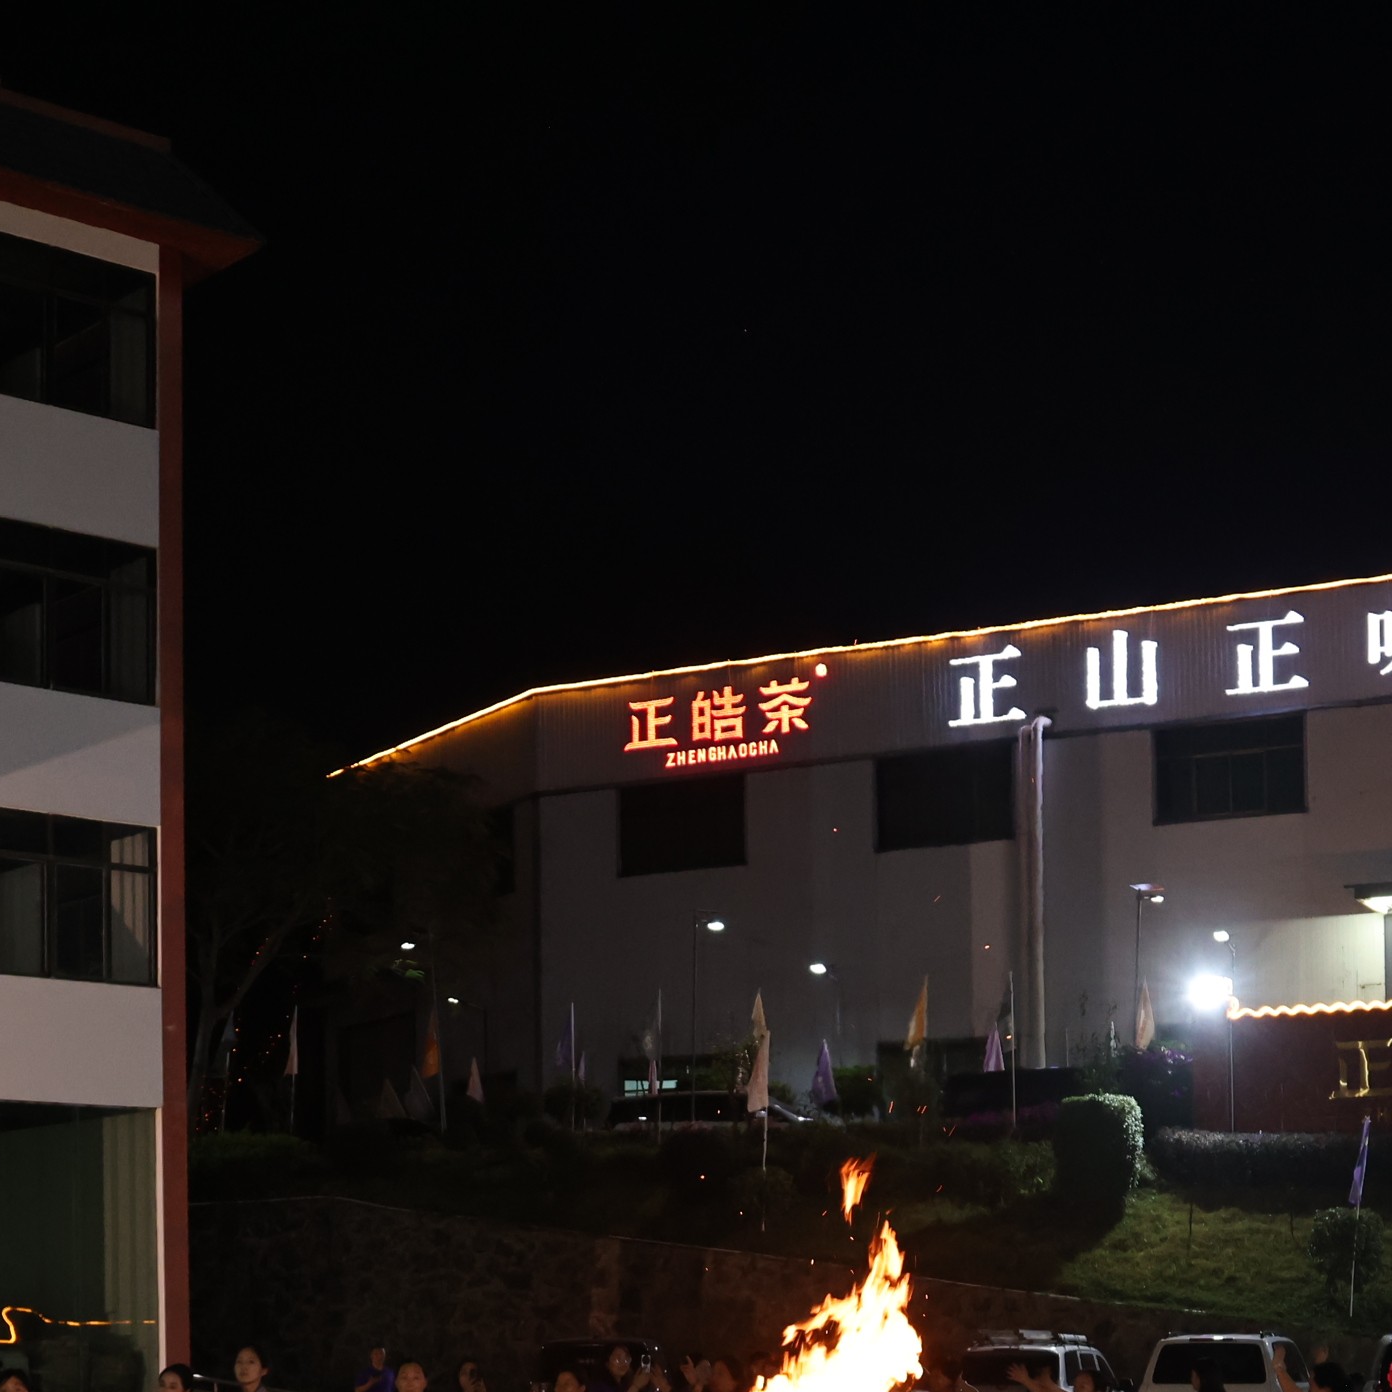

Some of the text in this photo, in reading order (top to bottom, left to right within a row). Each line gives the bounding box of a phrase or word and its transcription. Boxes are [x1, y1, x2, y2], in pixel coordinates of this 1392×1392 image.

[623, 676, 813, 752] 正皓茶
[664, 739, 780, 769] ZHENGHAOCHA
